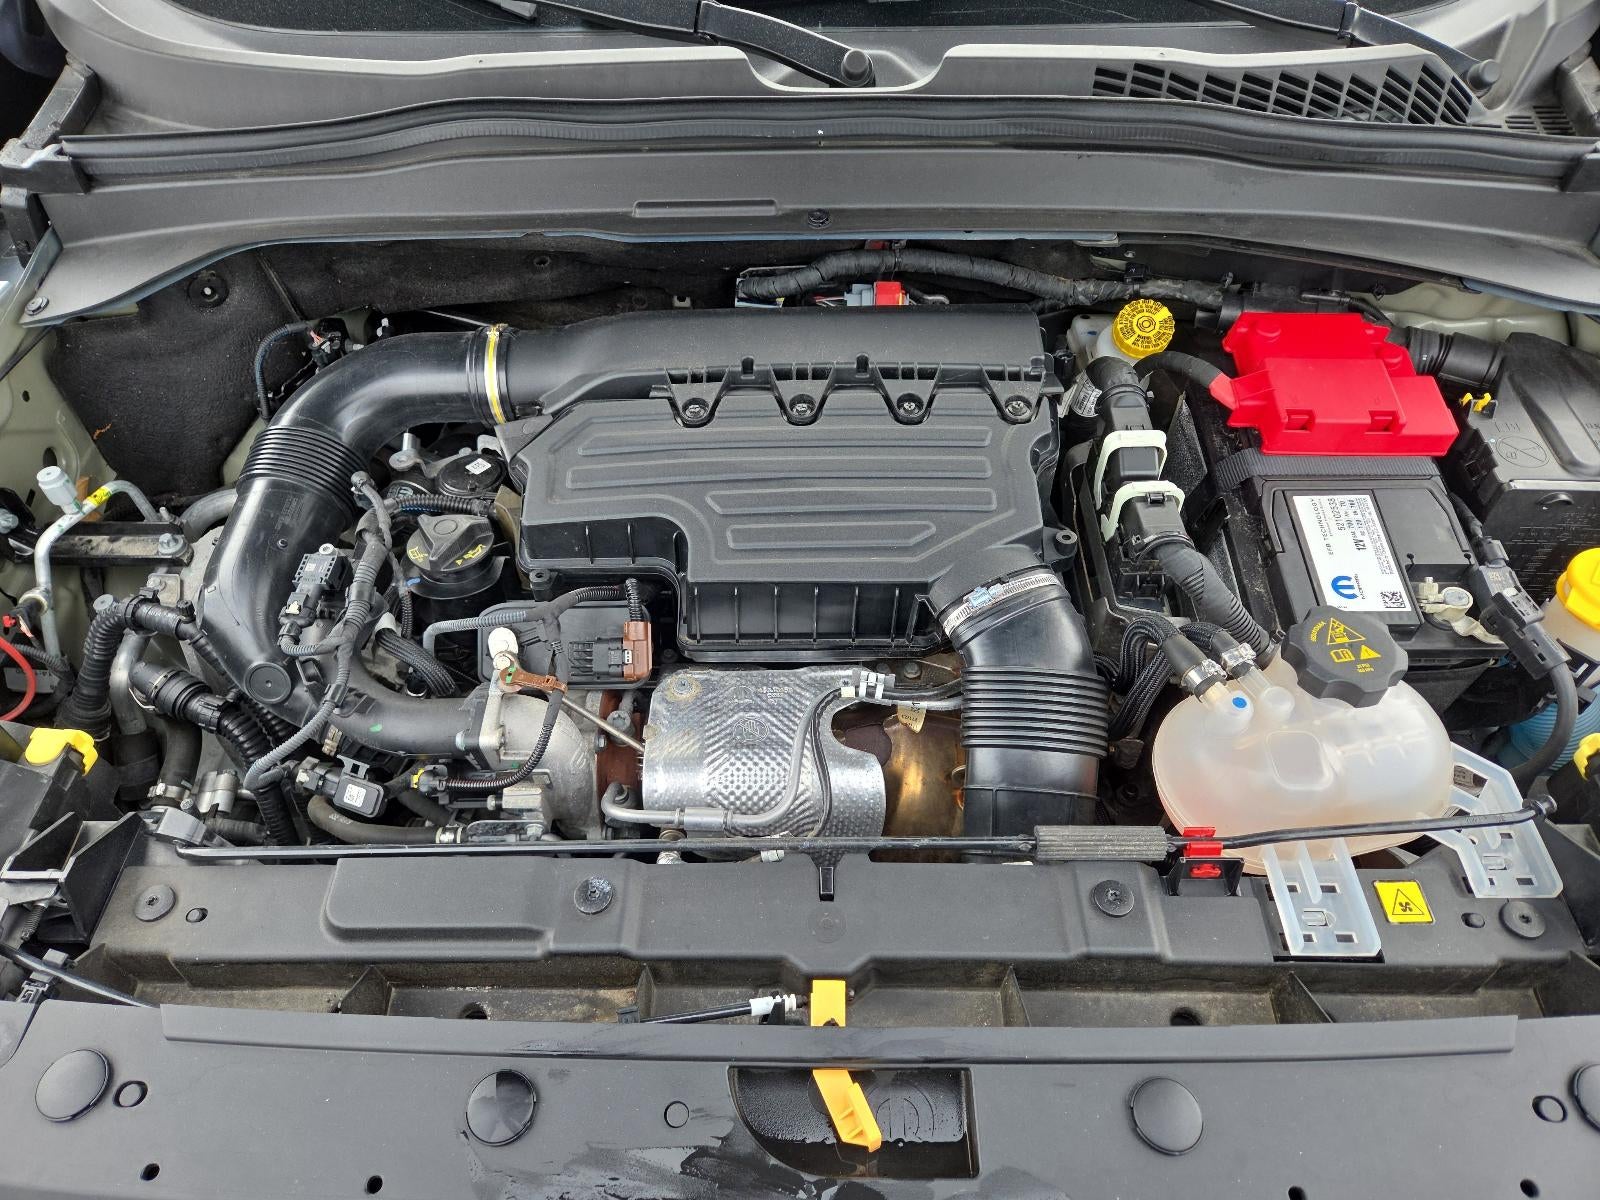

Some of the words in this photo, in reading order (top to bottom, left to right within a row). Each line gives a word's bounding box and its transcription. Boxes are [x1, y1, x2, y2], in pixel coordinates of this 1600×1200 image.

[1310, 498, 1328, 540] TECHNOLOGY
[1325, 543, 1333, 555] EFB
[1354, 539, 1366, 551] 12V
